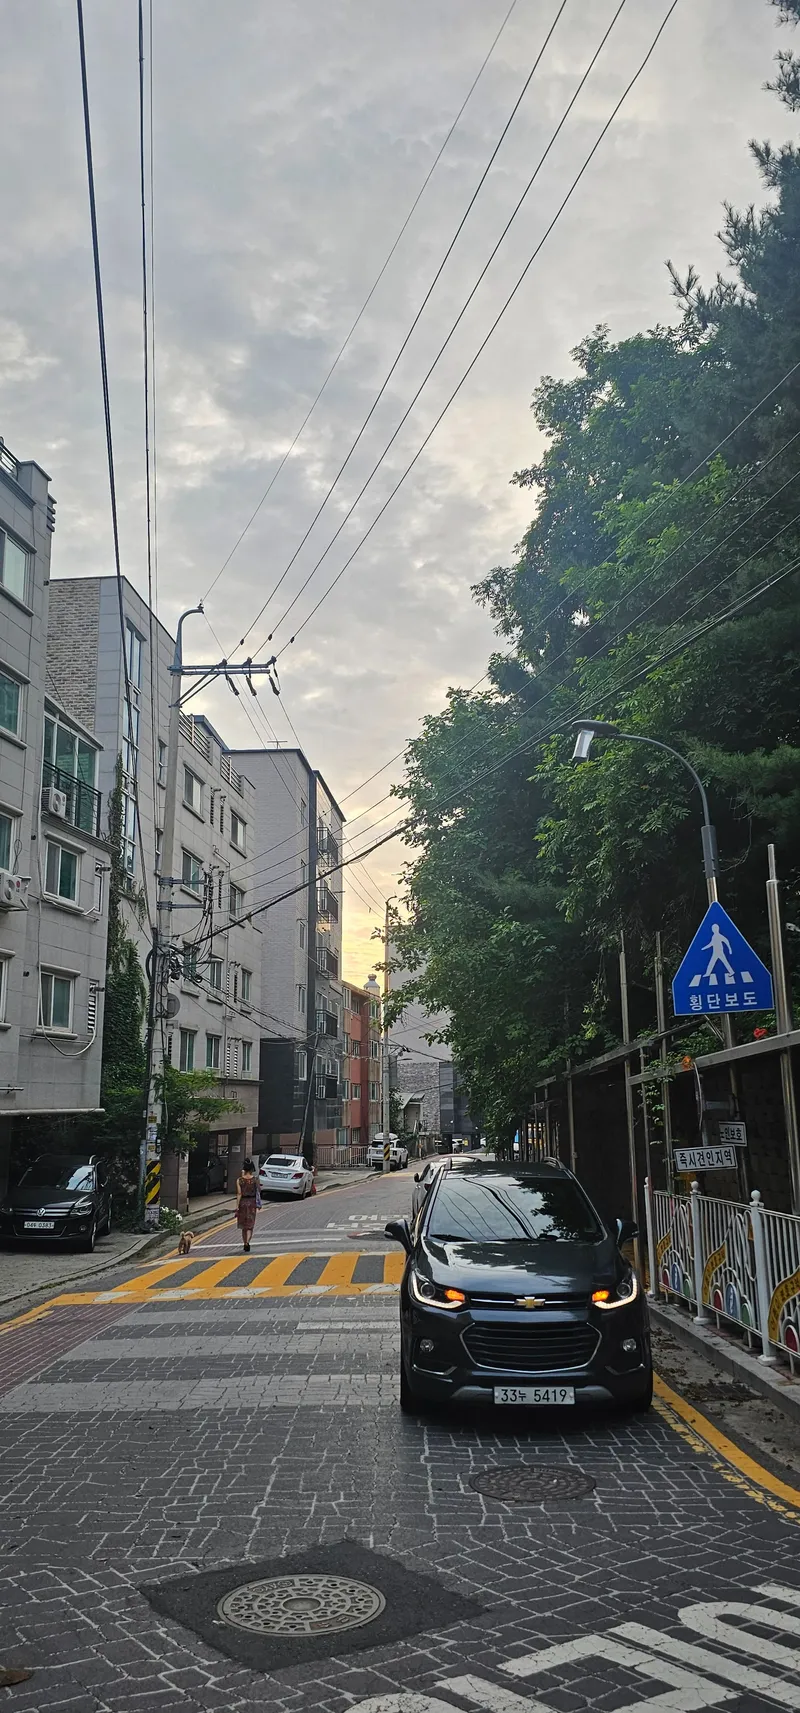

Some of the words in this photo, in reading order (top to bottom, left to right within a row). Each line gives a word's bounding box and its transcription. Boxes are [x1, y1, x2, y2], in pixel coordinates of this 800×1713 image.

[689, 991, 757, 1011] 횡단보도
[679, 1148, 733, 1168] 즉시견인지역
[501, 1389, 526, 1402] 33누
[534, 1389, 567, 1402] 5419
